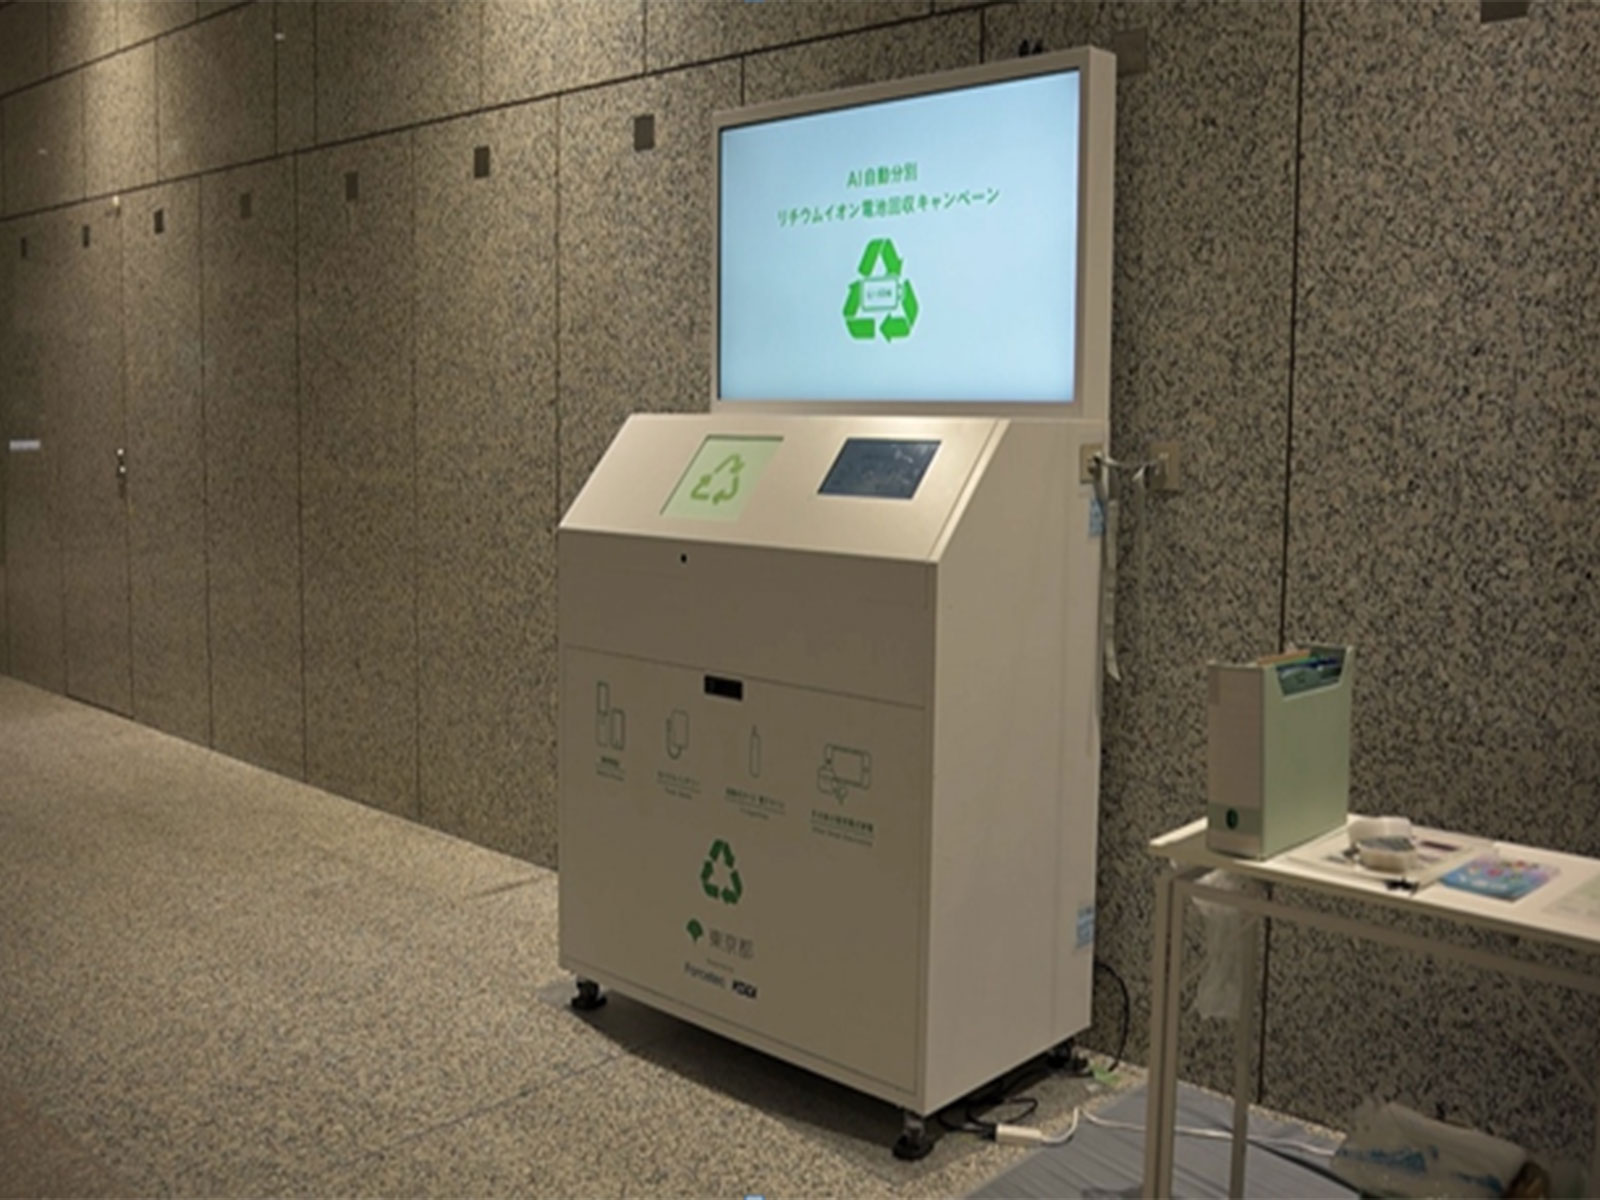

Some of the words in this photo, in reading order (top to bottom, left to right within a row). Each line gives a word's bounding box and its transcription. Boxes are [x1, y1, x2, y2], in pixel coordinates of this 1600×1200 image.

[847, 162, 918, 188] AI自動分別
[777, 187, 1000, 227] リチウムイオン電池回収キャンペーン
